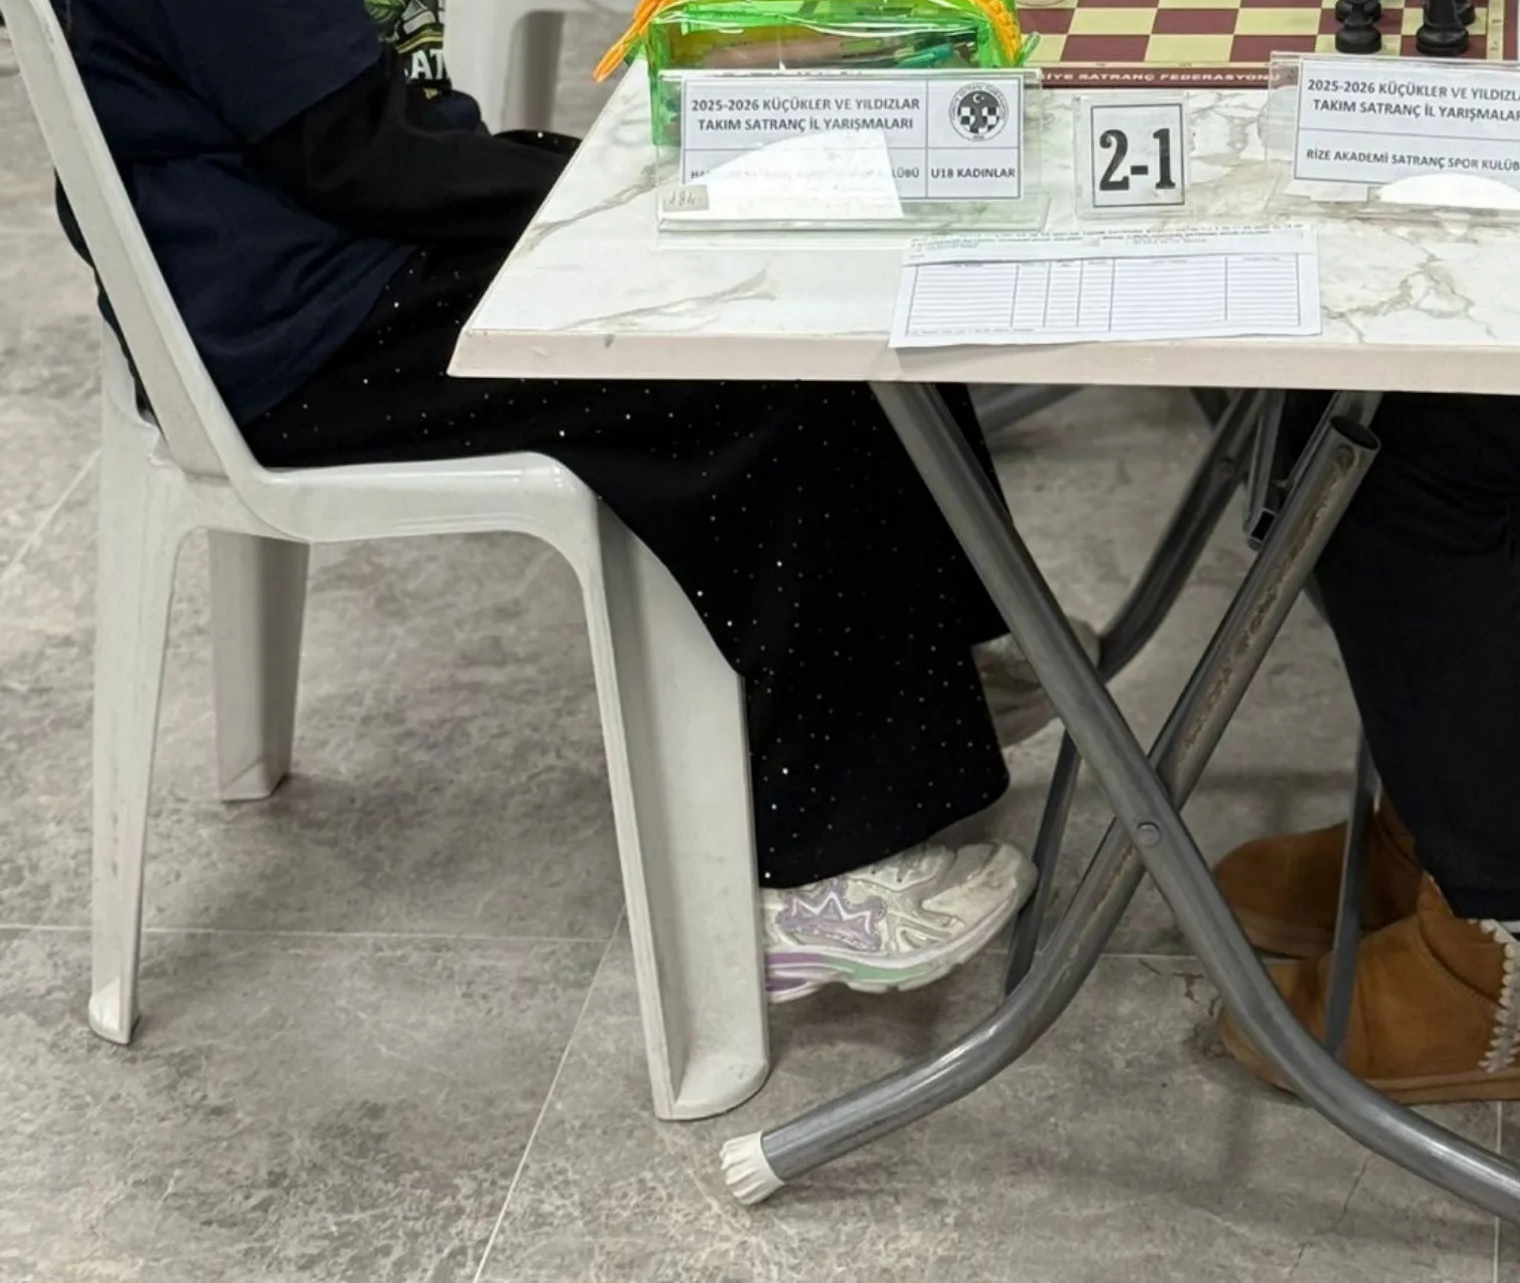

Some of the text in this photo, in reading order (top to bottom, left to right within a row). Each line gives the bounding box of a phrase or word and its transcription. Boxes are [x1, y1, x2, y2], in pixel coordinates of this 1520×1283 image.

[1307, 79, 1376, 94] 2025-2026
[1379, 80, 1447, 99] KÜÇÜKLER
[1451, 87, 1467, 99] VE
[691, 95, 920, 114] 2025-2026 KÜÇÜKLER VE YILDIZLAR
[1313, 99, 1356, 113] TAKIM
[1359, 101, 1421, 119] SATRANÇ
[1424, 101, 1435, 116] İL
[698, 115, 913, 134] TAKIM SATRANÇ İL YARIŞMALARI
[1099, 127, 1176, 191] 2-1
[1306, 147, 1331, 161] RİZE
[1334, 150, 1389, 164] AKADEMİ
[1391, 153, 1445, 169] SATRANÇ
[1448, 157, 1478, 170] SPOR
[931, 168, 1015, 179] U18 KADINLAR
